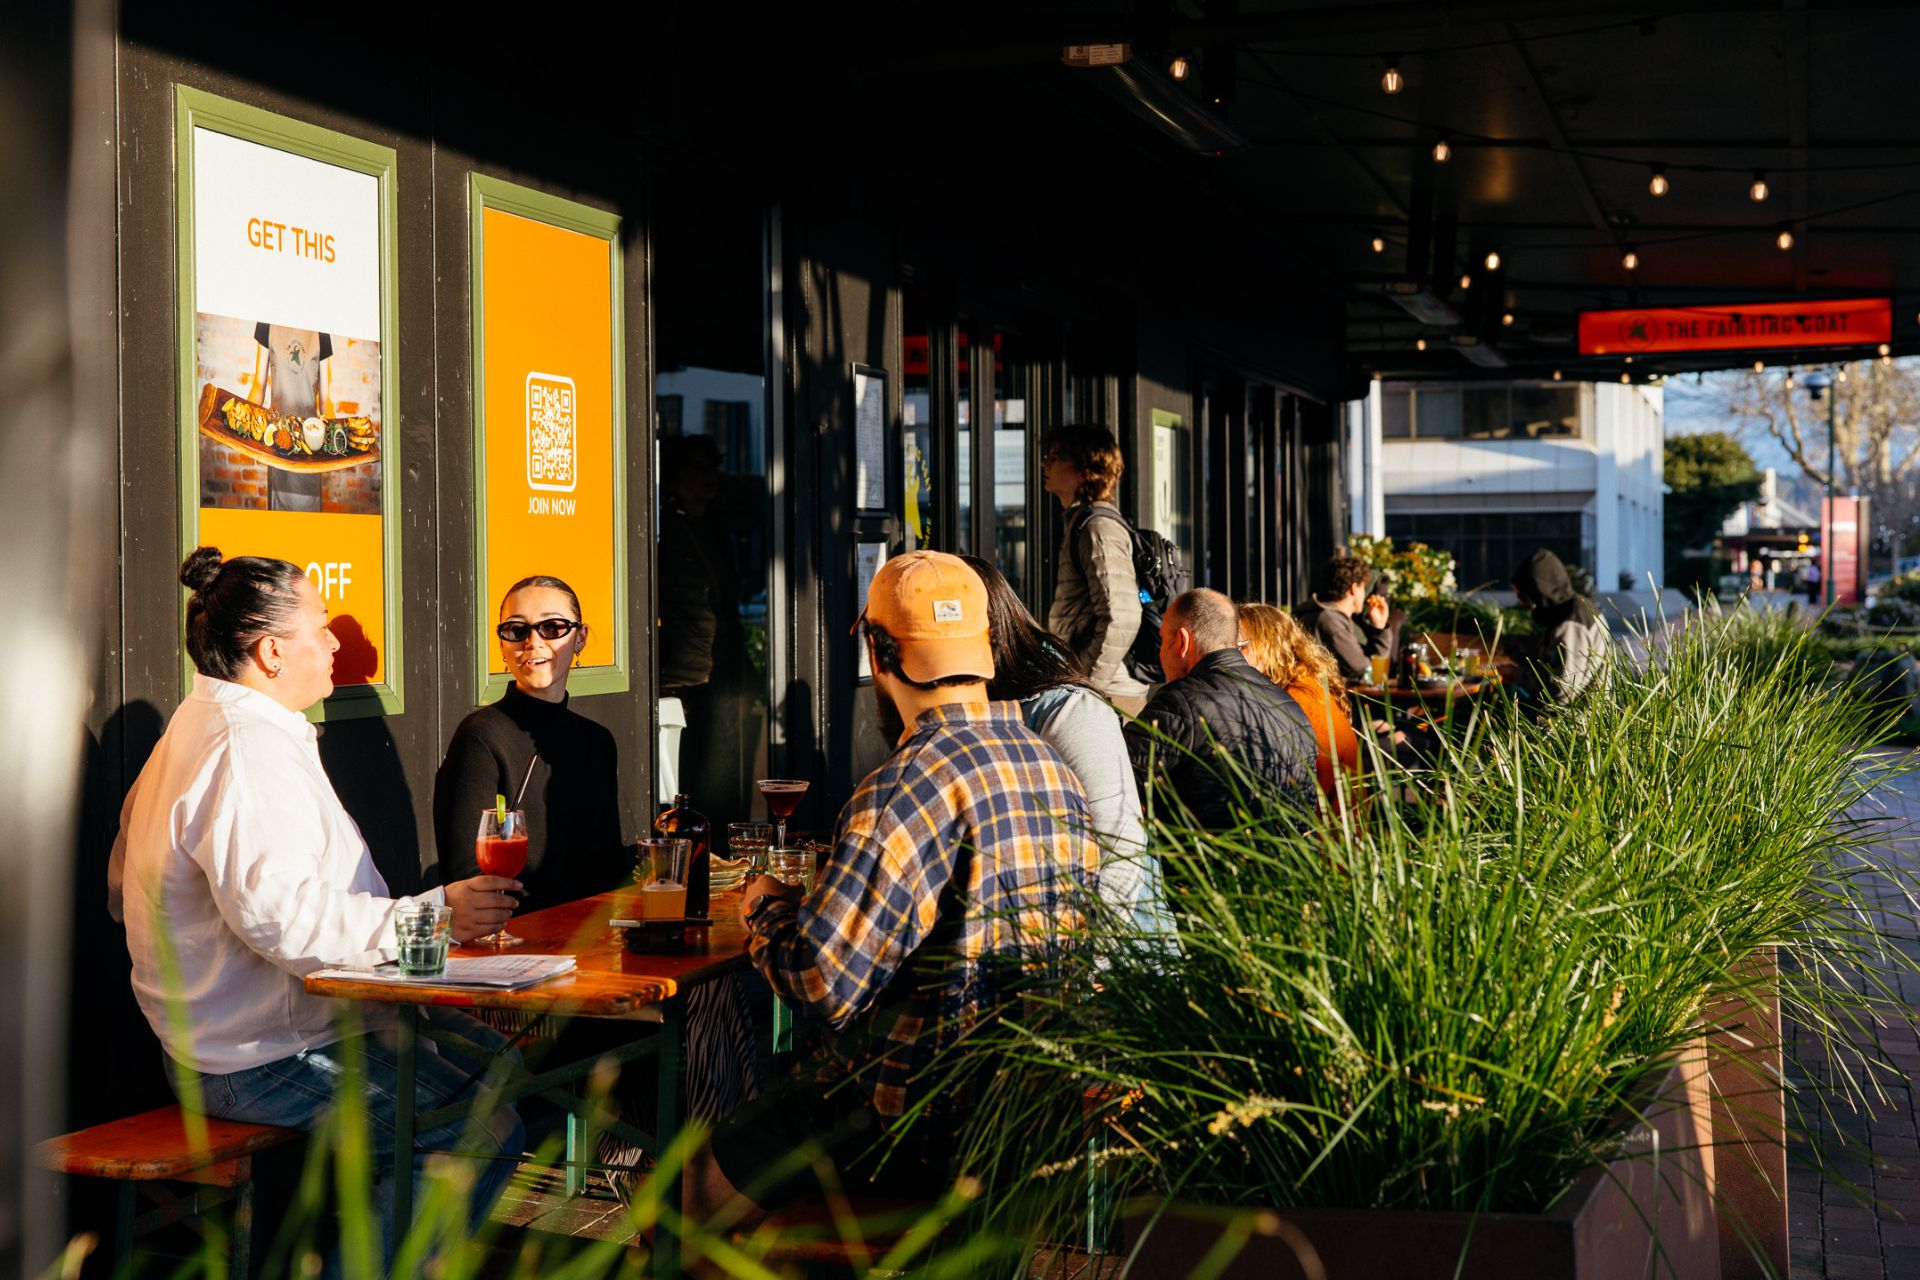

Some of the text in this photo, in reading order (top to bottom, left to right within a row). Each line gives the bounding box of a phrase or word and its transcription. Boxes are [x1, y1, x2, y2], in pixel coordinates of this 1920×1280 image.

[247, 217, 336, 263] GET THIS
[1666, 319, 1700, 338] THE
[1802, 312, 1849, 334] GOAT
[528, 496, 577, 516] JOIN NOW
[304, 561, 353, 601] OFF
